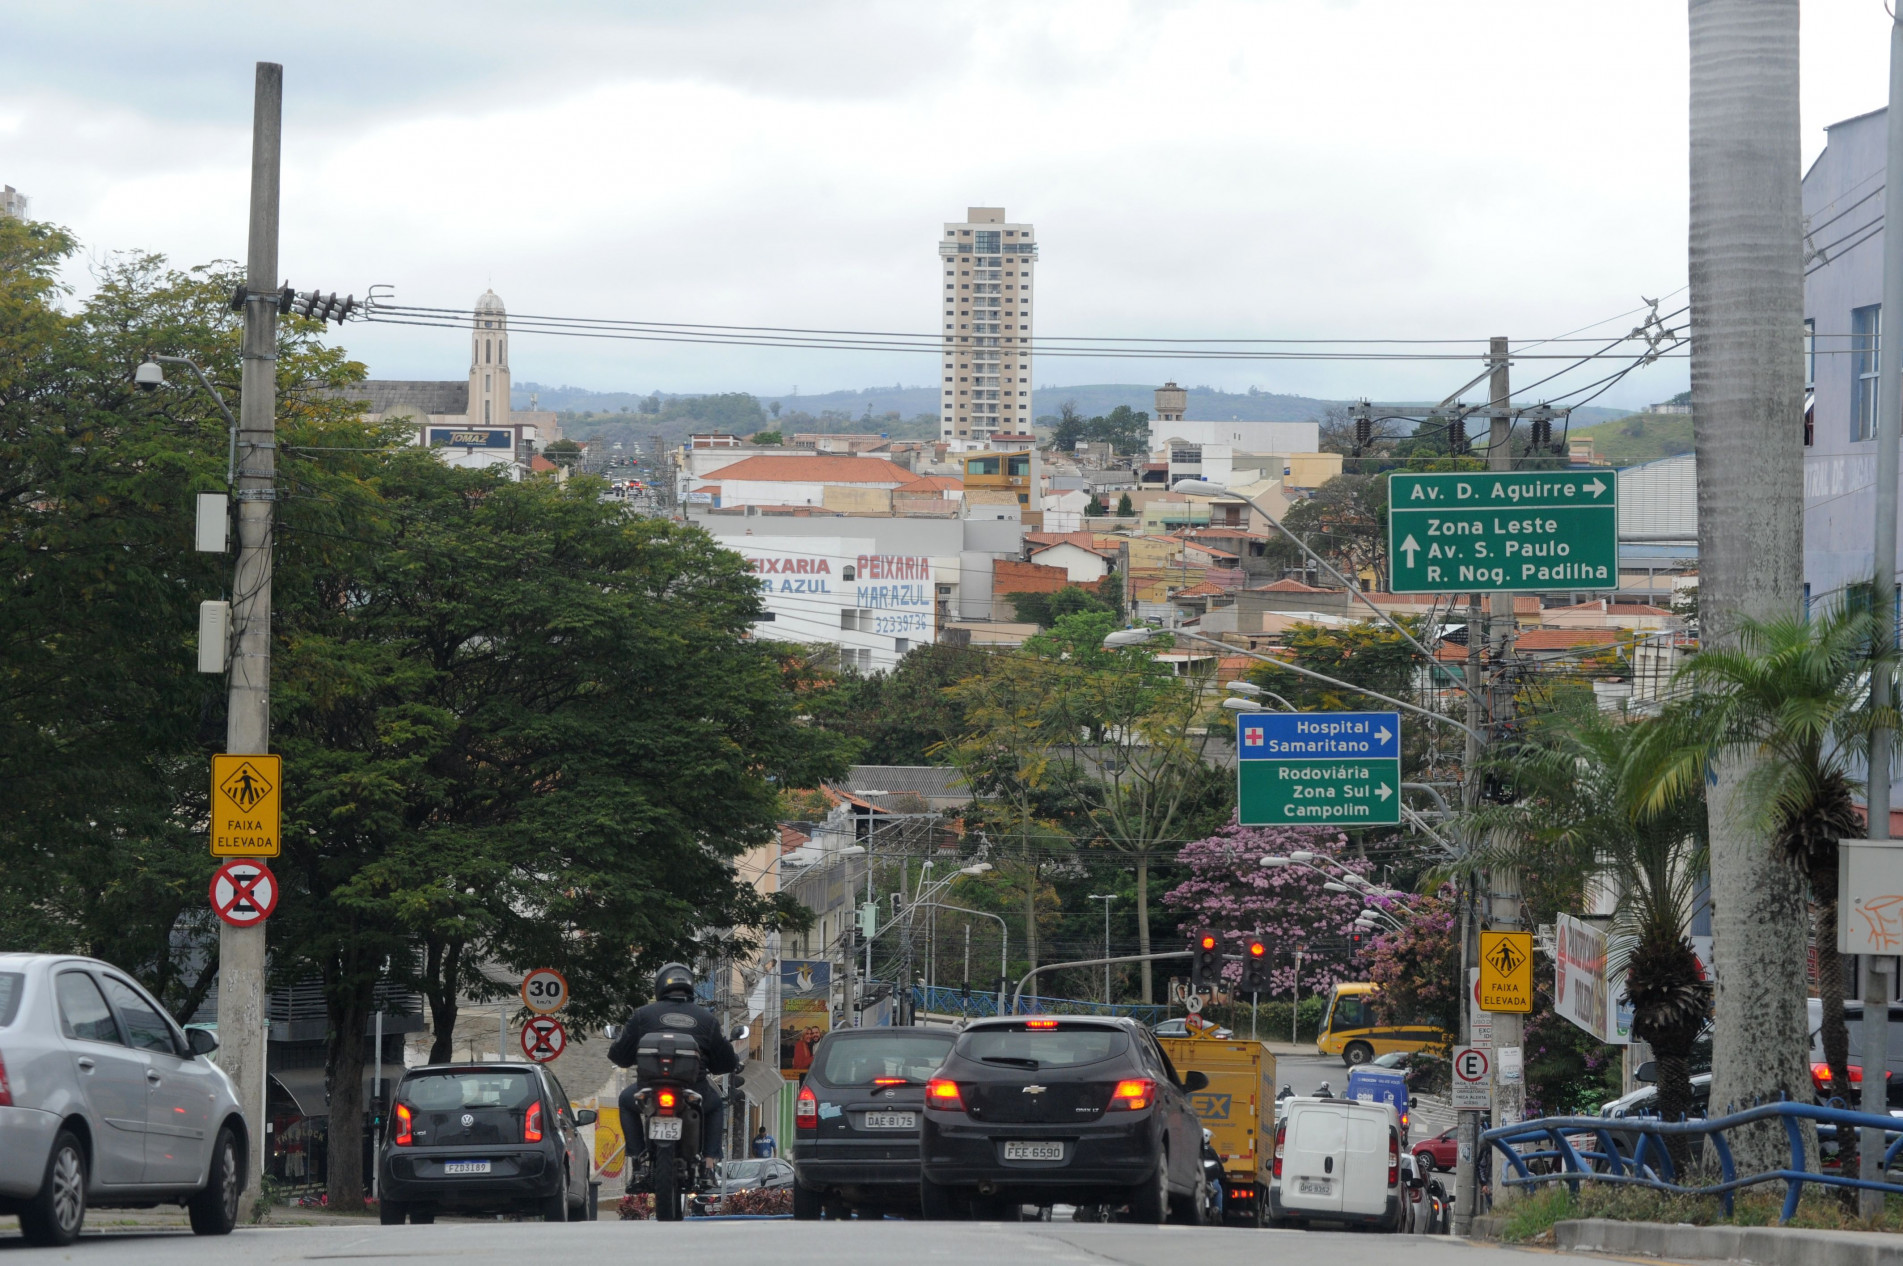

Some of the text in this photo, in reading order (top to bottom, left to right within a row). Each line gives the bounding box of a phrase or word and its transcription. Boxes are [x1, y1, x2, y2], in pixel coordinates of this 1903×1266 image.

[449, 431, 490, 445] TOMAZ
[1804, 461, 1829, 498] TRAL
[1410, 480, 1576, 502] Av. D. Aguirre
[1427, 517, 1558, 535] Zona Leste
[1427, 540, 1570, 559] Av. S. Paulo
[746, 558, 831, 575] EIXARIA
[857, 554, 929, 581] PEIXARIA
[1427, 562, 1608, 585] R. Nog. Padilha
[780, 579, 831, 593] AZUL
[875, 613, 927, 634] 32339736
[1297, 720, 1369, 736] Hospital
[1269, 739, 1370, 752] Samaritano
[1279, 765, 1369, 780] Rodoviária
[1293, 784, 1370, 798] Zona Sul
[1283, 803, 1369, 819] Campolim
[228, 820, 263, 831] FAIXA
[218, 836, 273, 848] ELEVADA
[529, 980, 560, 997] 30
[1491, 983, 1518, 992] FAIXA
[1484, 996, 1526, 1005] ELEVADA
[1465, 1056, 1478, 1075] E
[652, 1130, 678, 1139] 7162
